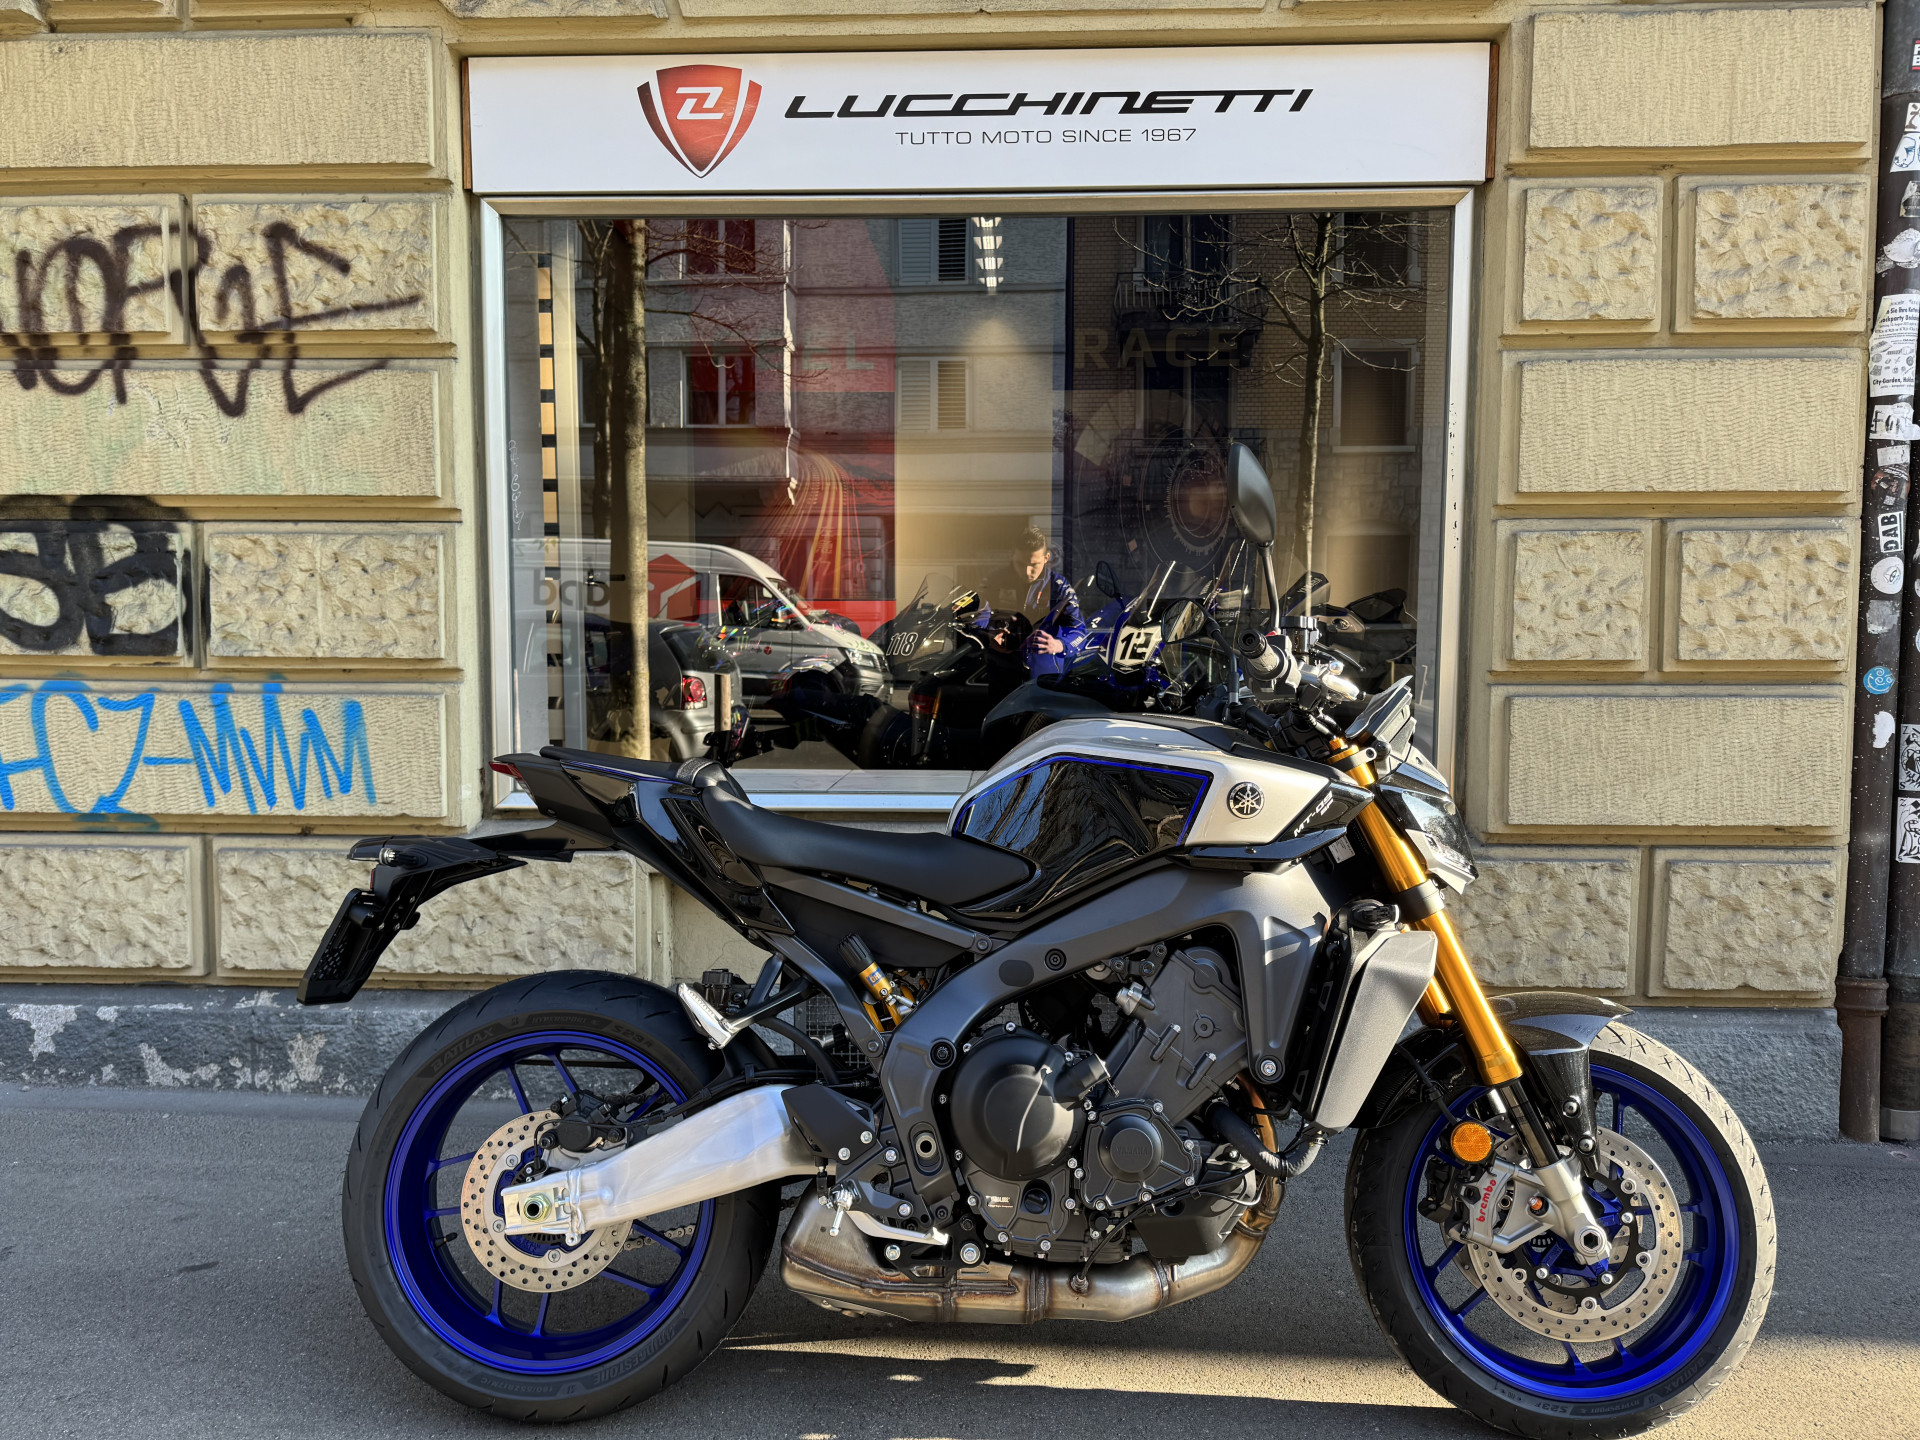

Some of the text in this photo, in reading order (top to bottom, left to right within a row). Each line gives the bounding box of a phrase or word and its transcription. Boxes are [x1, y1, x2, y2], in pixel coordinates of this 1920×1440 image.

[784, 89, 1314, 119] LUCCHINETTI
[896, 128, 1198, 145] TUTTO MOTO SINCE 1967
[1073, 327, 1240, 370] RACE
[1881, 514, 1899, 552] DAB
[886, 631, 919, 657] 118
[430, 1027, 496, 1073] BATTLAX
[1475, 1179, 1497, 1223] brembo
[592, 1325, 675, 1385] BRIDGESTONE
